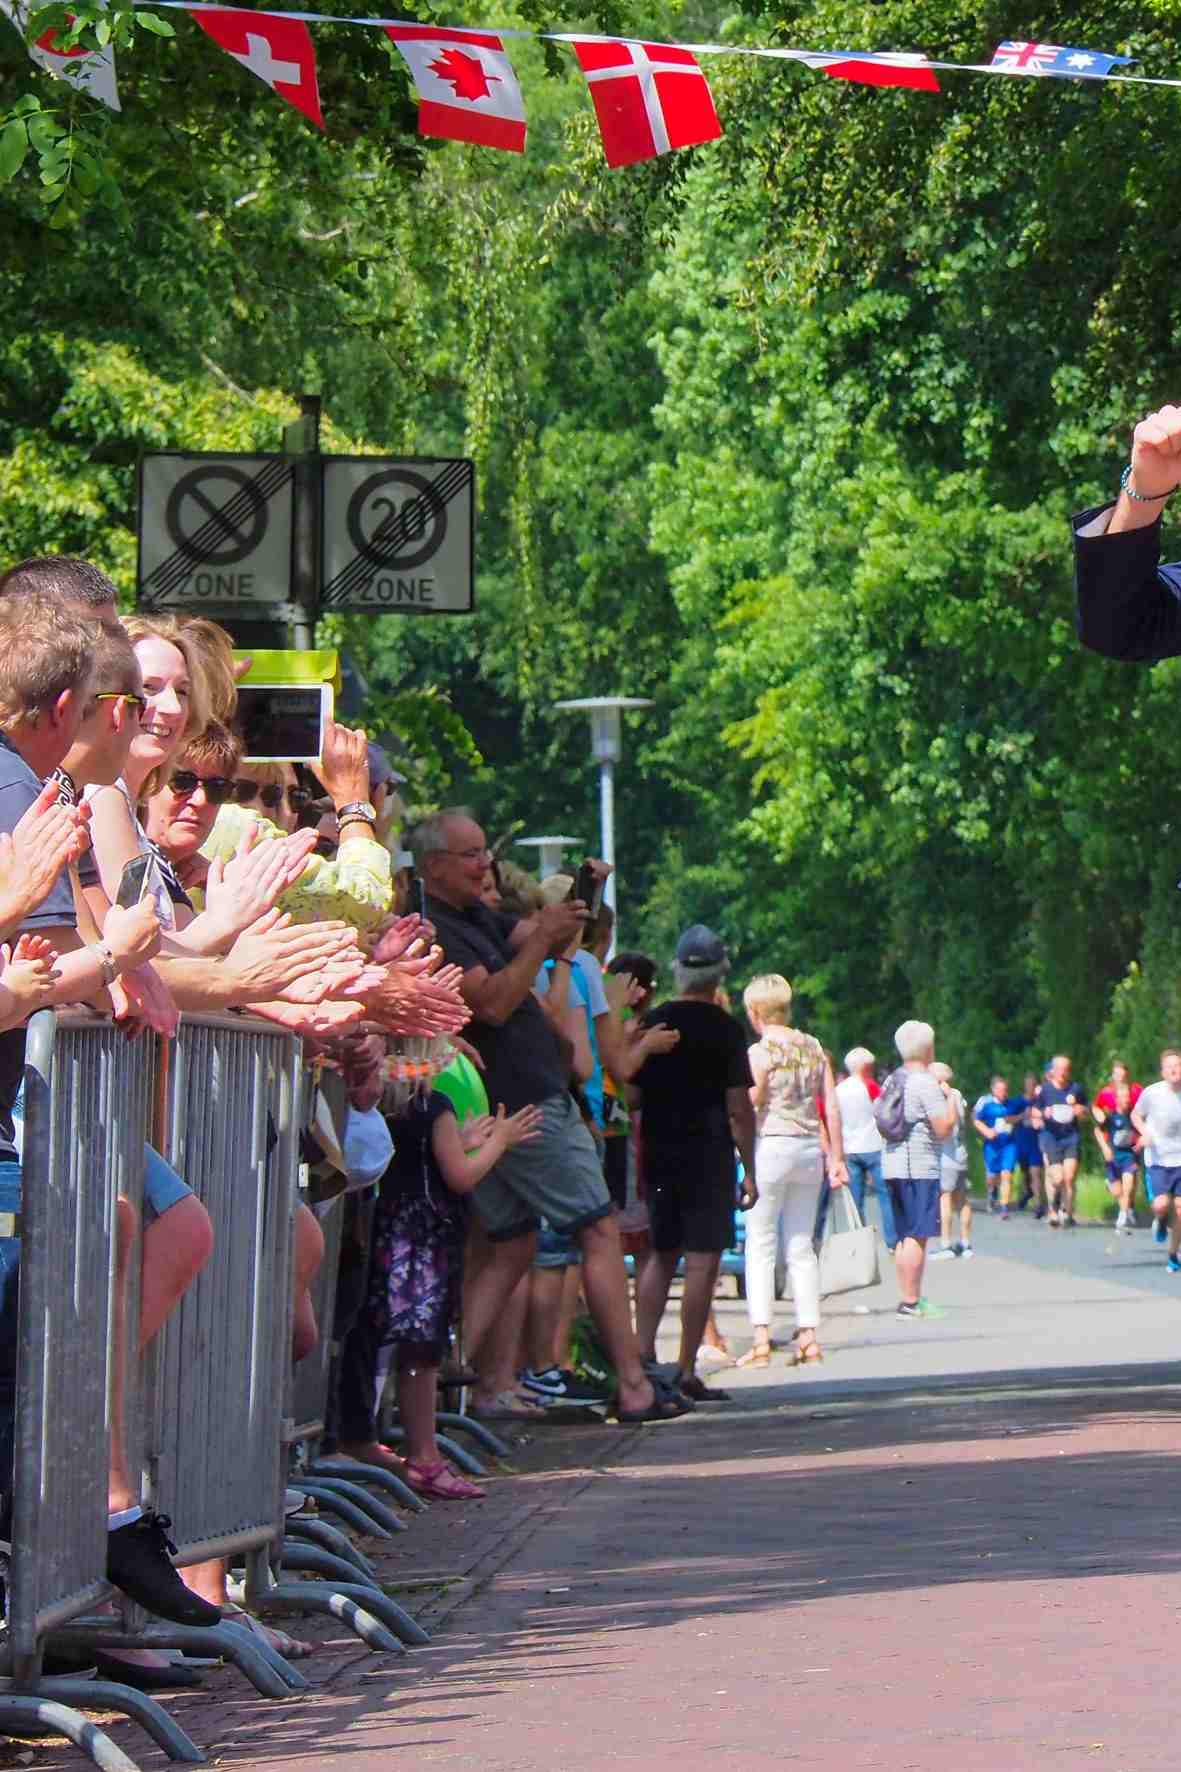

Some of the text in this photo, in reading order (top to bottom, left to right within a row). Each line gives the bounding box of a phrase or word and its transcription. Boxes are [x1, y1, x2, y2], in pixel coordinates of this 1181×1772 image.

[371, 497, 426, 542] 20
[178, 573, 255, 597] ZONE
[361, 578, 434, 601] ZONE
